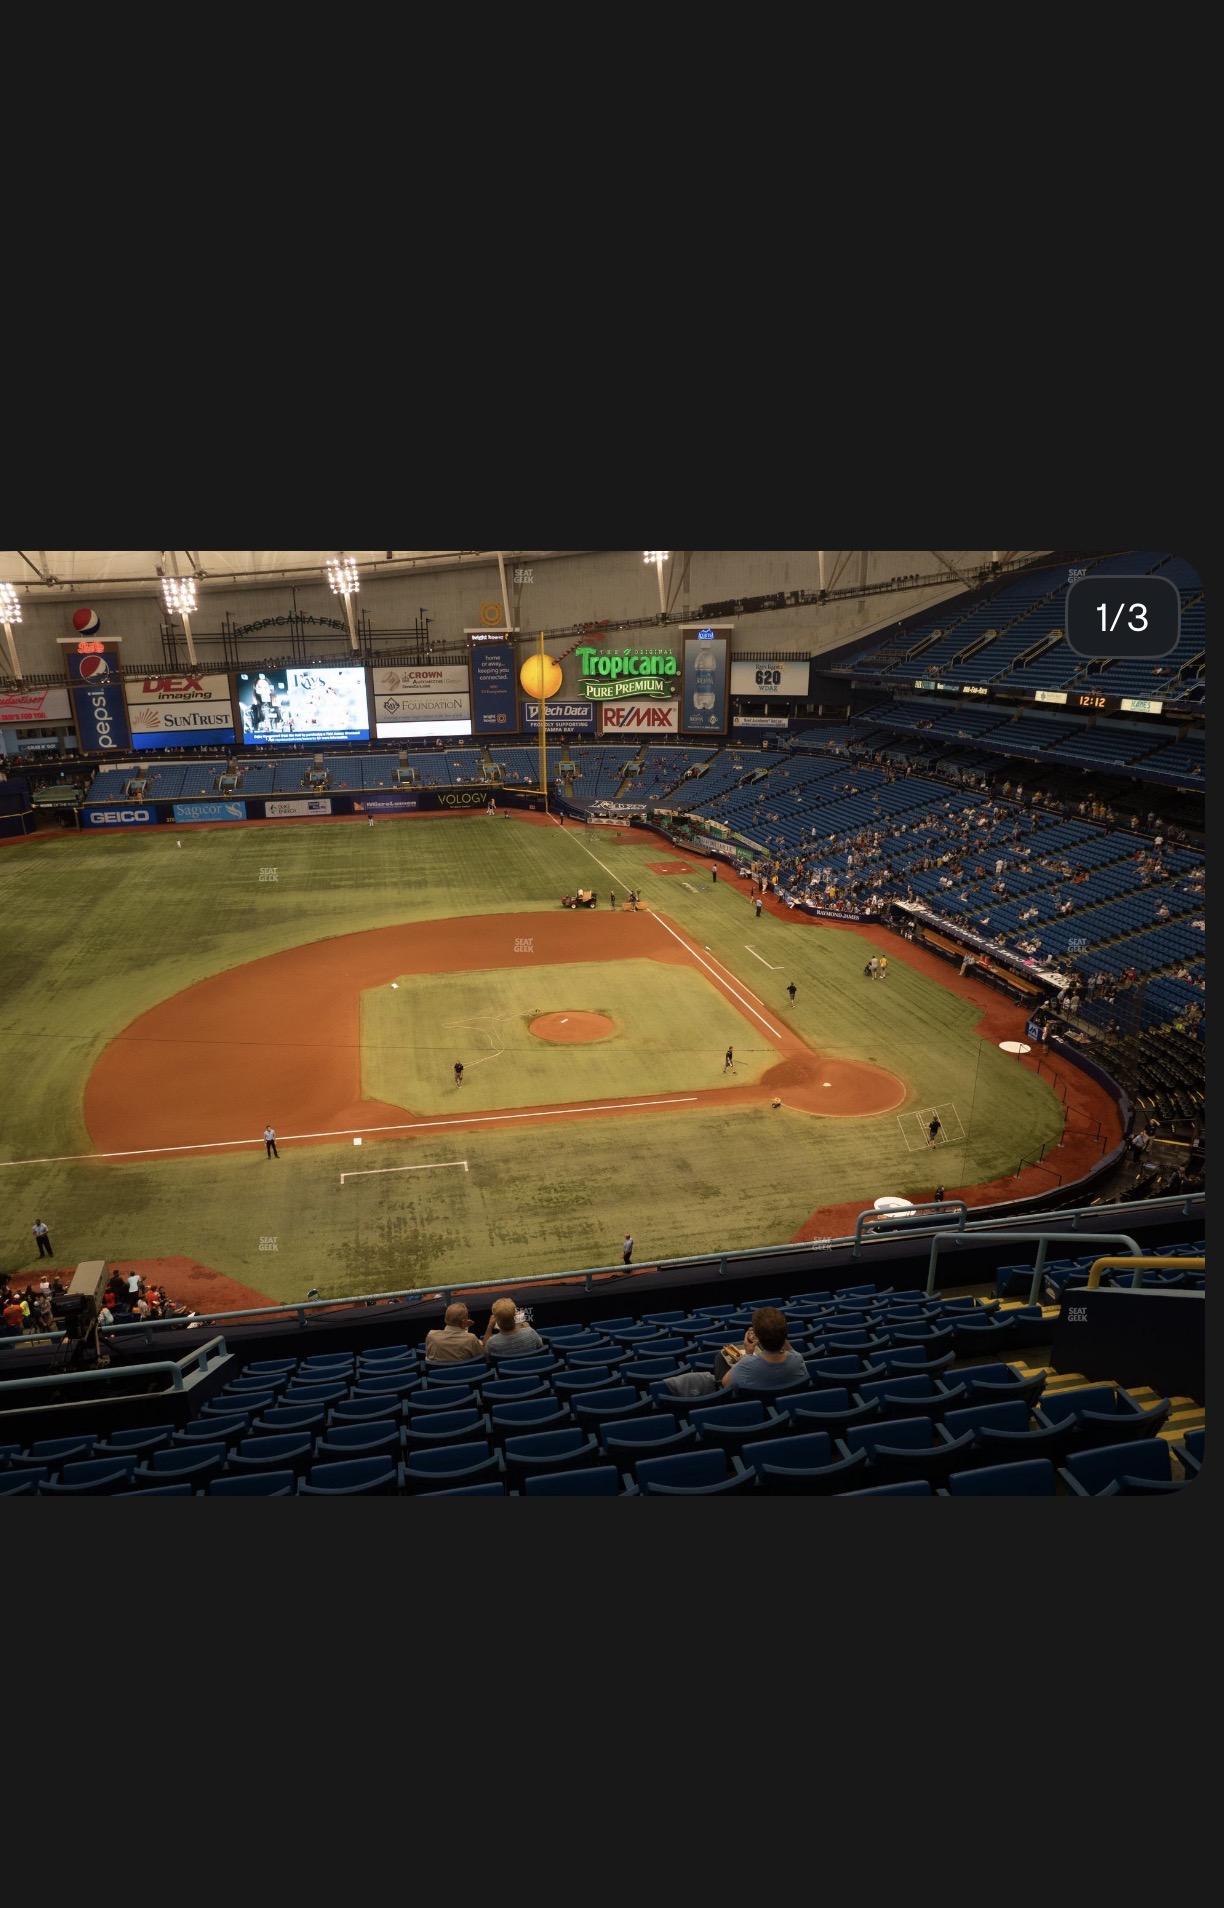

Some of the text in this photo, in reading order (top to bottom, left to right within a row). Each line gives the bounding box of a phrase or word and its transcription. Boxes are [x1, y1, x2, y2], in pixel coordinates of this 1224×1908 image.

[234, 616, 316, 638] TROPICANA
[576, 647, 677, 679] Tropicana
[409, 671, 442, 679] CROWN
[756, 671, 780, 685] 620
[143, 677, 203, 693] DEX
[586, 680, 664, 697] PURE PREMIUM
[158, 691, 212, 700] imaging
[1080, 695, 1106, 708] 12:12
[403, 699, 463, 711] FOUNDATION
[564, 706, 589, 716] Data
[88, 691, 117, 748] pepsi
[604, 707, 673, 728] RE/MAX
[438, 793, 487, 805] VOLOGY
[90, 810, 150, 824] GEICO
[176, 804, 221, 818] Sagicor
[816, 909, 843, 918] RAYMOND
